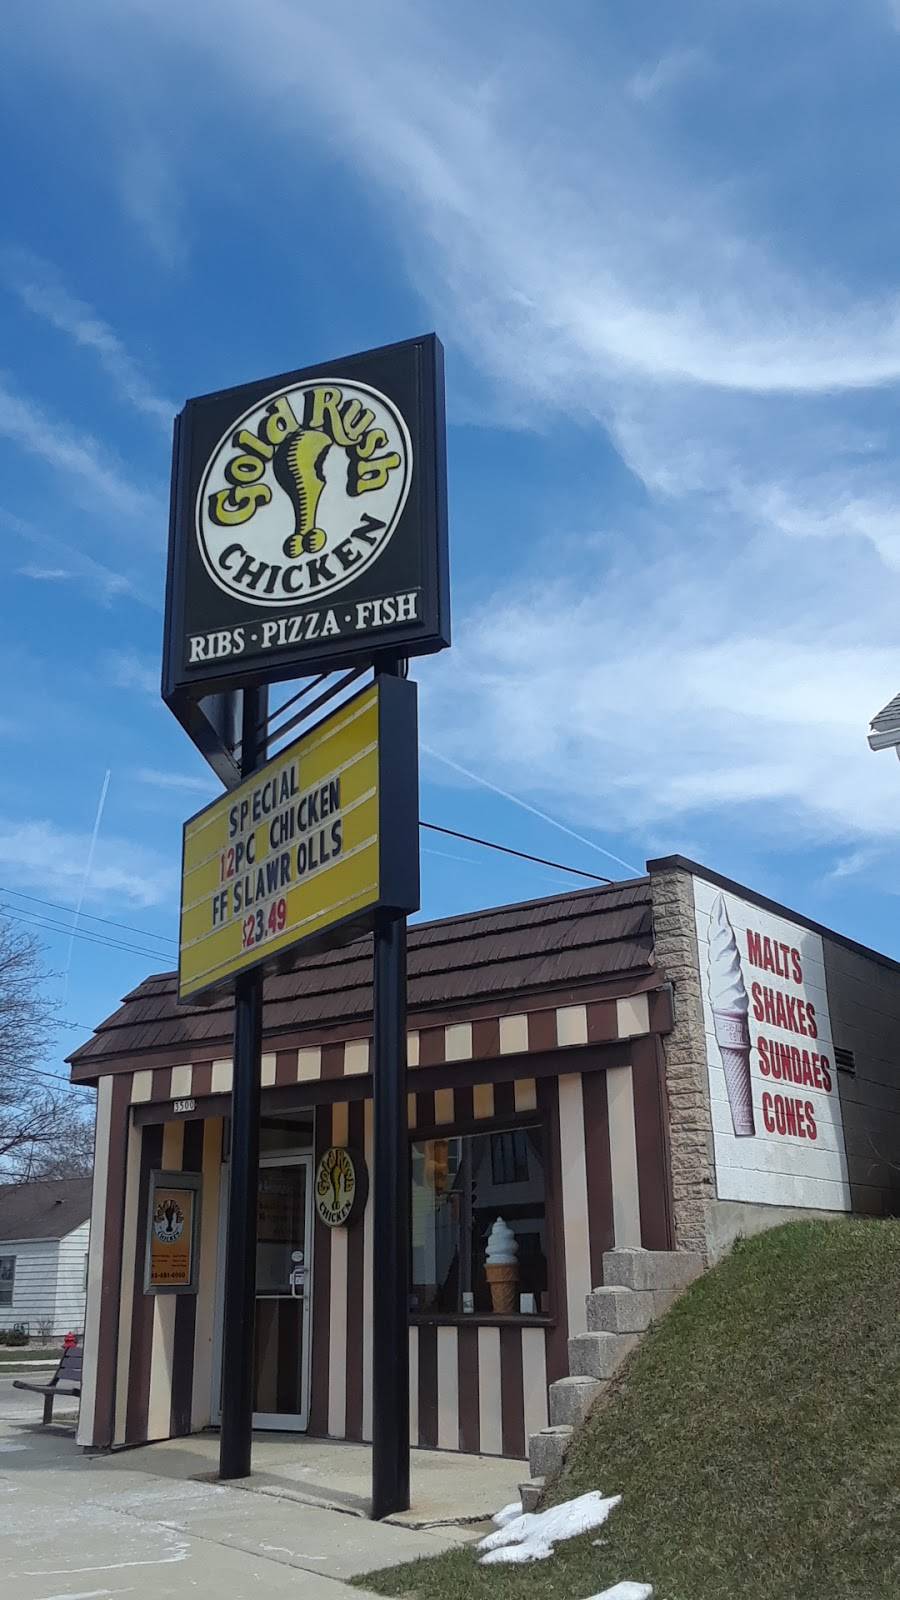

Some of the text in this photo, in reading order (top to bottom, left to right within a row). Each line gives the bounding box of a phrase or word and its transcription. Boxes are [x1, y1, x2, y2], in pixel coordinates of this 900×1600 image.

[208, 386, 401, 526] Gold Rush
[219, 513, 387, 593] CHICKEN
[189, 593, 418, 662] RIBS PIZZA FISH
[220, 777, 341, 882] 12PC CHICKEN
[229, 766, 299, 838] SPECIAL
[212, 889, 229, 926] FF
[242, 898, 287, 948] $23.49
[746, 928, 803, 985] MALTS
[751, 981, 818, 1039] SHAKES
[757, 1036, 832, 1092] SUNDAES
[762, 1091, 818, 1140] CONES
[317, 1150, 336, 1196] Gold
[319, 1199, 352, 1222] CHICKEN
